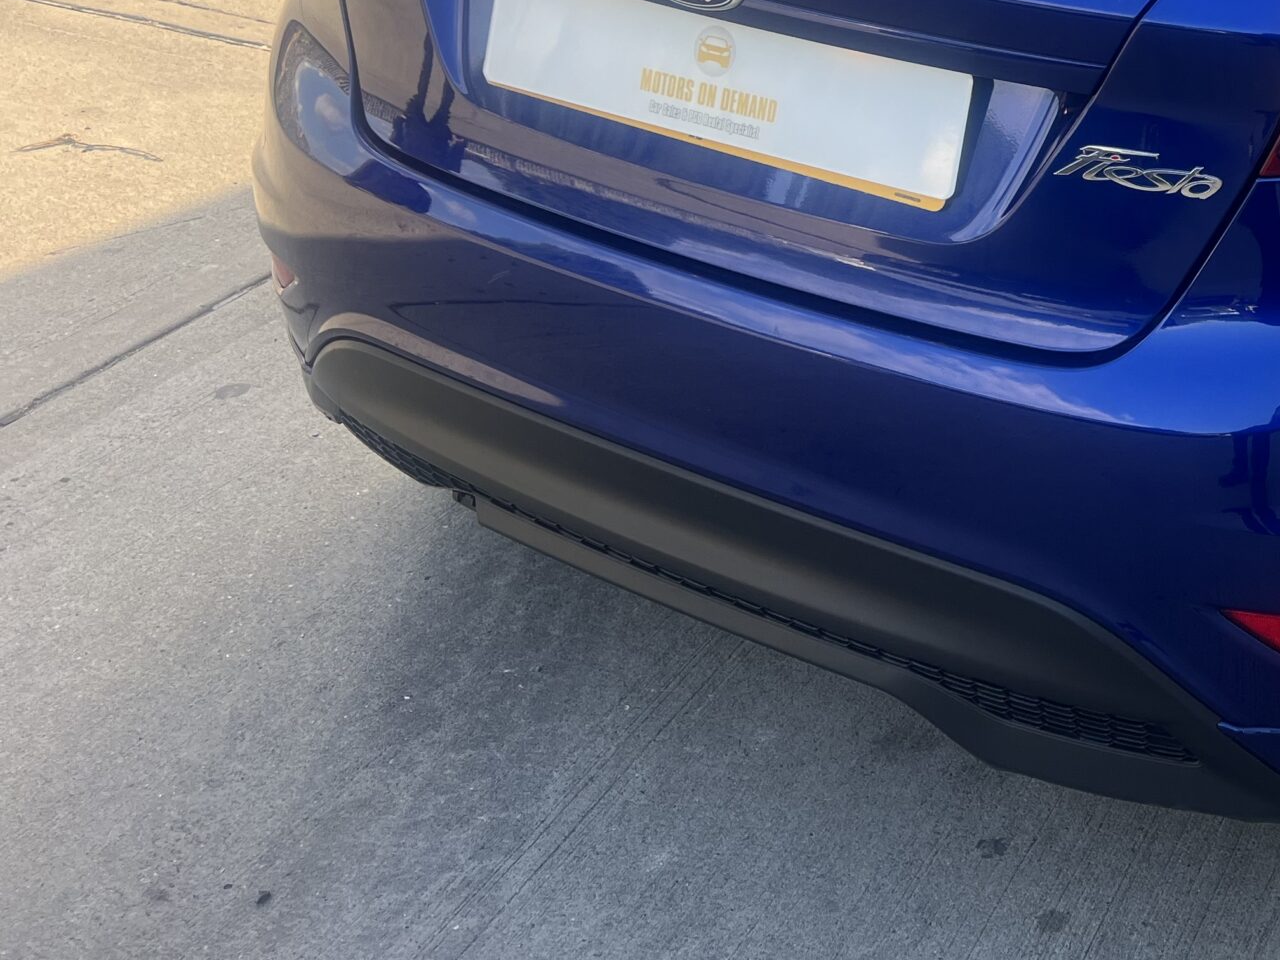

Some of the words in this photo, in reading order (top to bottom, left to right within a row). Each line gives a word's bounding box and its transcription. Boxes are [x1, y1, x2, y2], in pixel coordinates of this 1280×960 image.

[640, 67, 694, 102] MOTORS
[698, 82, 718, 108] ON
[720, 87, 778, 123] DEMAND
[1053, 145, 1223, 200] Fiesta
